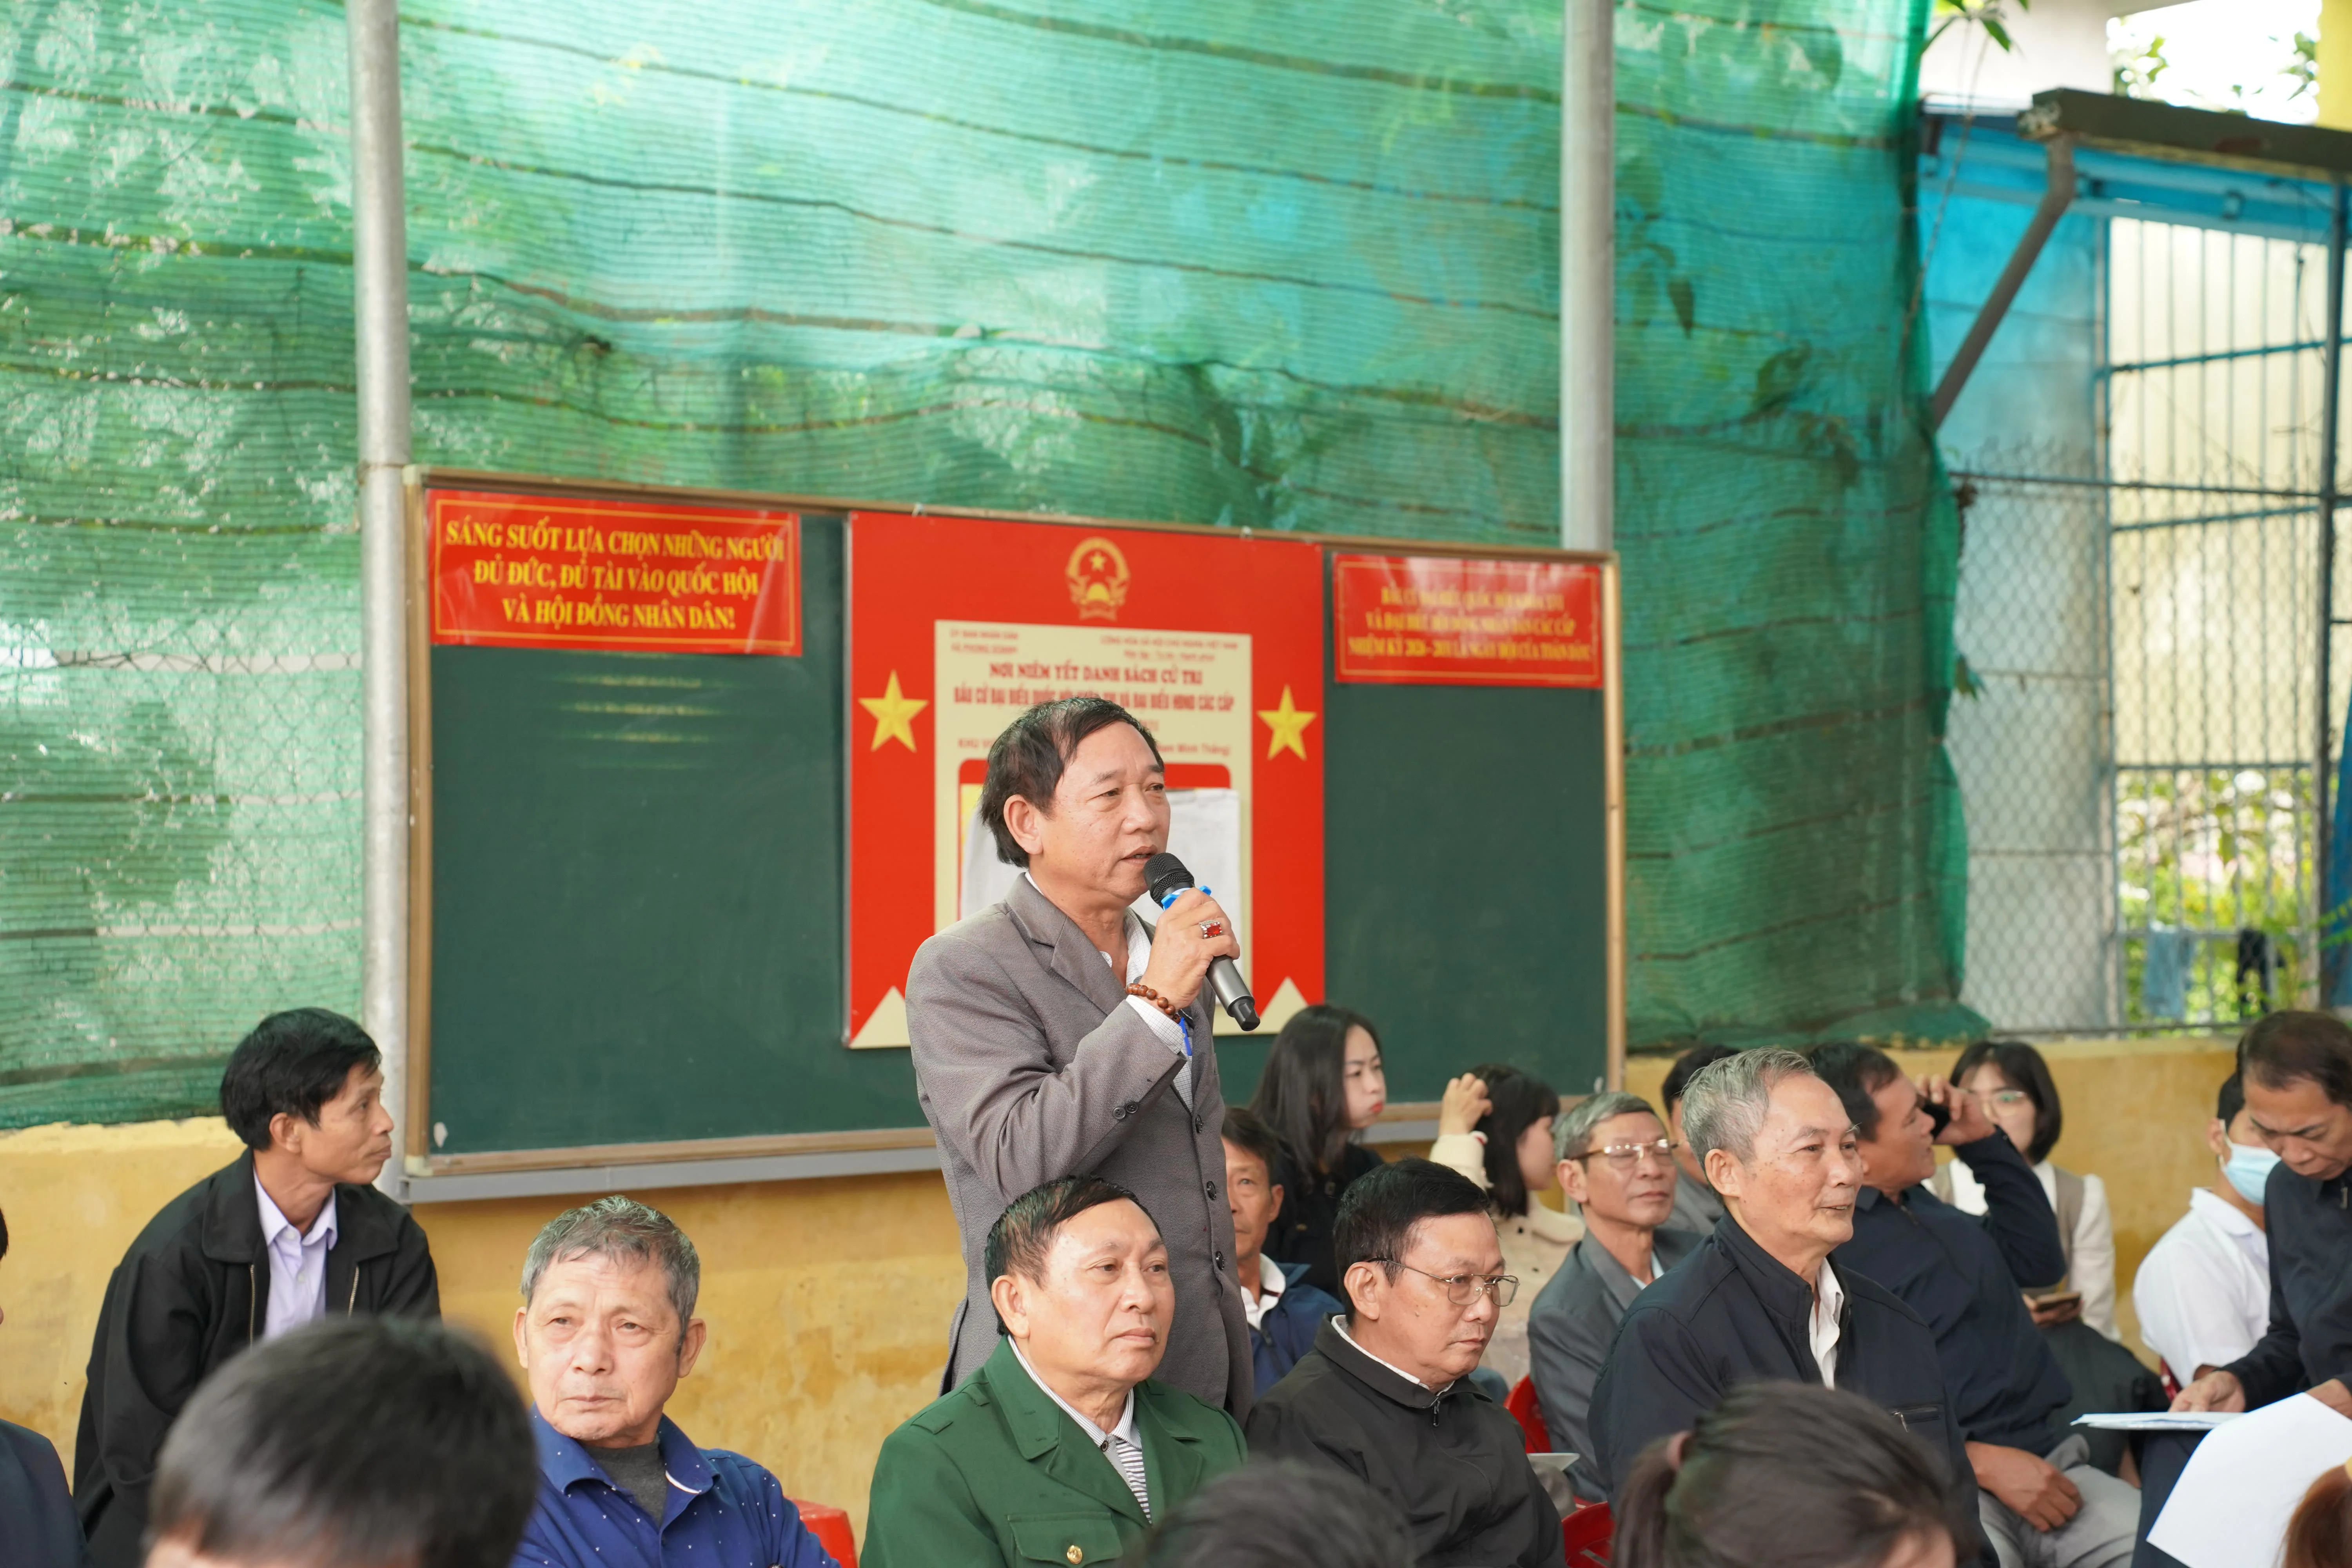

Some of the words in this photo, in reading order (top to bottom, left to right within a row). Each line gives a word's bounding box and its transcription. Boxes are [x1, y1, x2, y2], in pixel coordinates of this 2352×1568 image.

[446, 515, 503, 548] SÁNG
[507, 516, 563, 551] SUỐT
[566, 526, 604, 558] LỰA
[608, 531, 659, 561] CHỌN
[663, 530, 722, 560] NHỮNG
[726, 533, 785, 562] NGƯỜI
[474, 553, 504, 585] ĐỦ
[507, 556, 557, 591] ĐỨC,
[560, 557, 587, 590] ĐỦ
[591, 561, 624, 591] TÀI
[627, 563, 664, 593] VÀO
[667, 562, 719, 598] QUỐC
[723, 566, 759, 600] HỘI
[503, 593, 530, 624] VÀ
[535, 594, 573, 630] HỘI
[576, 594, 629, 627] ĐỒNG
[632, 599, 686, 629] NHÂN
[689, 601, 736, 630] DÂN!
[989, 661, 1014, 677] NƠI
[1054, 658, 1080, 680] YẾT
[1083, 665, 1120, 682] DANH
[1124, 664, 1158, 683] SÁCH
[1161, 664, 1179, 684] CỬ
[1182, 669, 1203, 686] TRI
